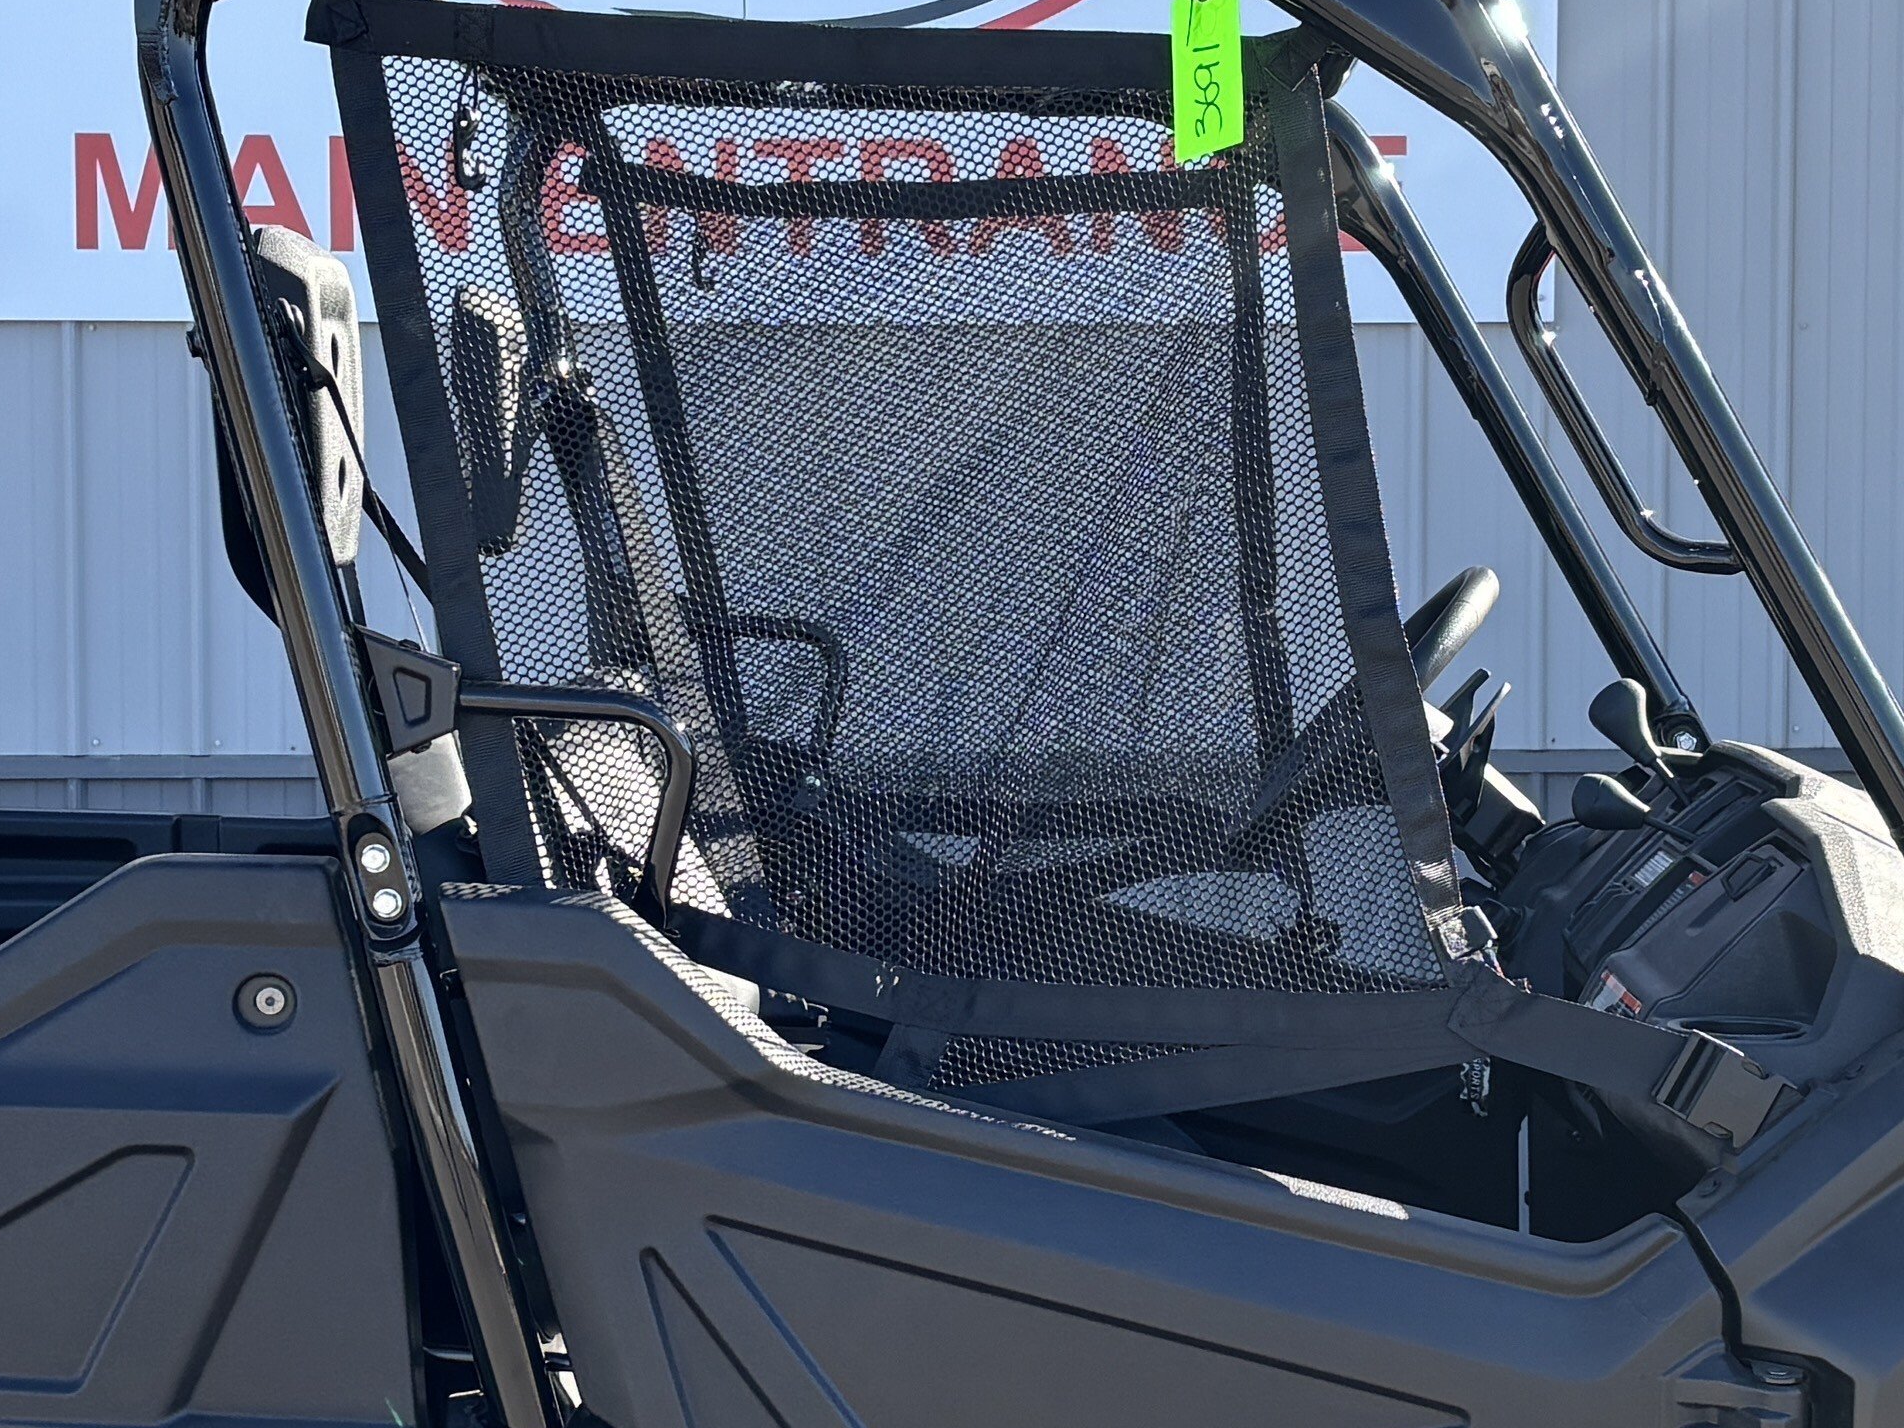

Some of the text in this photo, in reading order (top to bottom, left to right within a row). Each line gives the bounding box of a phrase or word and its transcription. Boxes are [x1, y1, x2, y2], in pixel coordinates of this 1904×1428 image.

[1192, 42, 1223, 139] 3691
[74, 132, 1408, 255] MAIN ENTRAN
